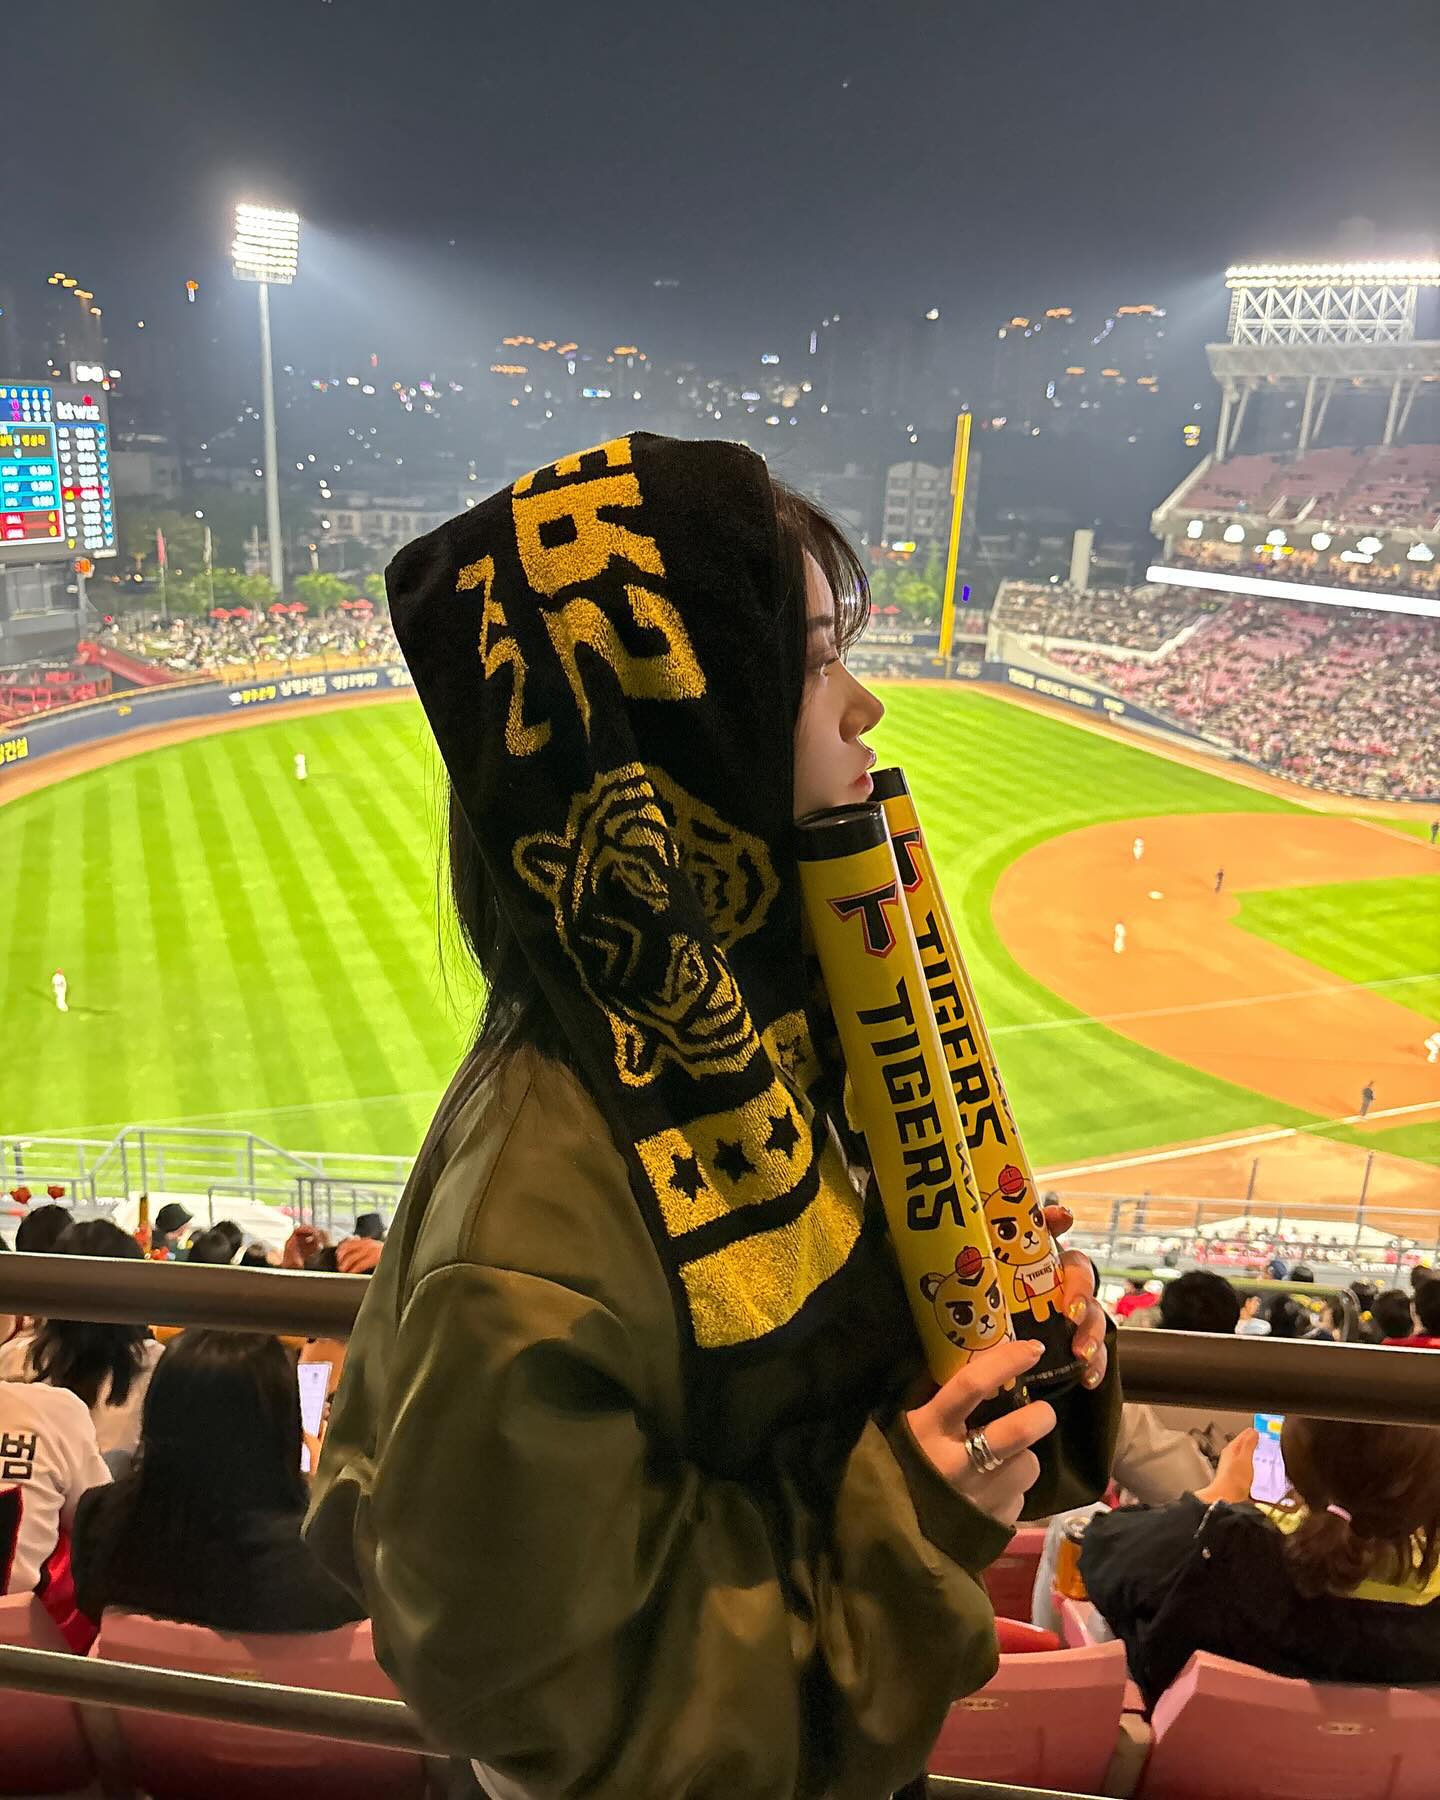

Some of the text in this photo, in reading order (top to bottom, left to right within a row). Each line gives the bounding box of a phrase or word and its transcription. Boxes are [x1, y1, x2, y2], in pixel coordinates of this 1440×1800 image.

[0, 736, 28, 765] 건설
[827, 881, 899, 959] T
[915, 910, 1009, 1149] TIGERS
[856, 976, 966, 1232] TIGERS
[1026, 1264, 1053, 1282] TIGERS
